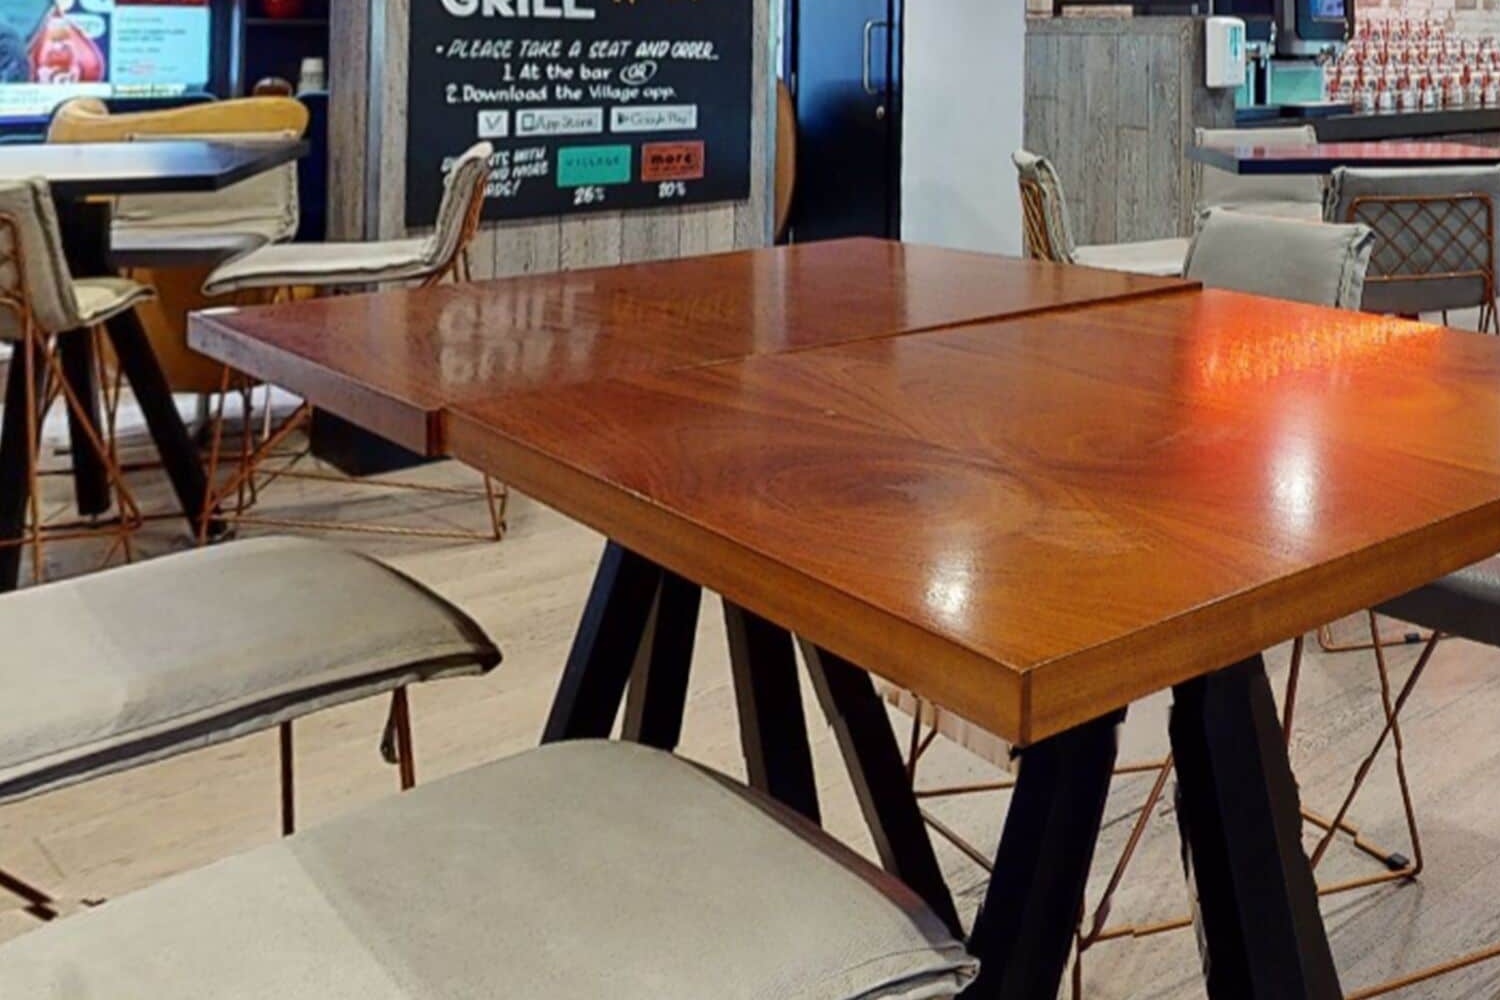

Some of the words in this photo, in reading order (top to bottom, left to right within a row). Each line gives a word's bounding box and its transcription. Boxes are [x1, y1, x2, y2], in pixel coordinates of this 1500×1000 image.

[447, 39, 514, 59] PLEASE
[519, 40, 561, 58] TAKE
[568, 40, 581, 58] A
[588, 40, 632, 58] SEAT
[635, 40, 670, 59] AND
[519, 64, 540, 81] At
[546, 63, 574, 81] the
[579, 63, 612, 80] bar
[555, 85, 582, 101] the
[589, 85, 639, 103] Village
